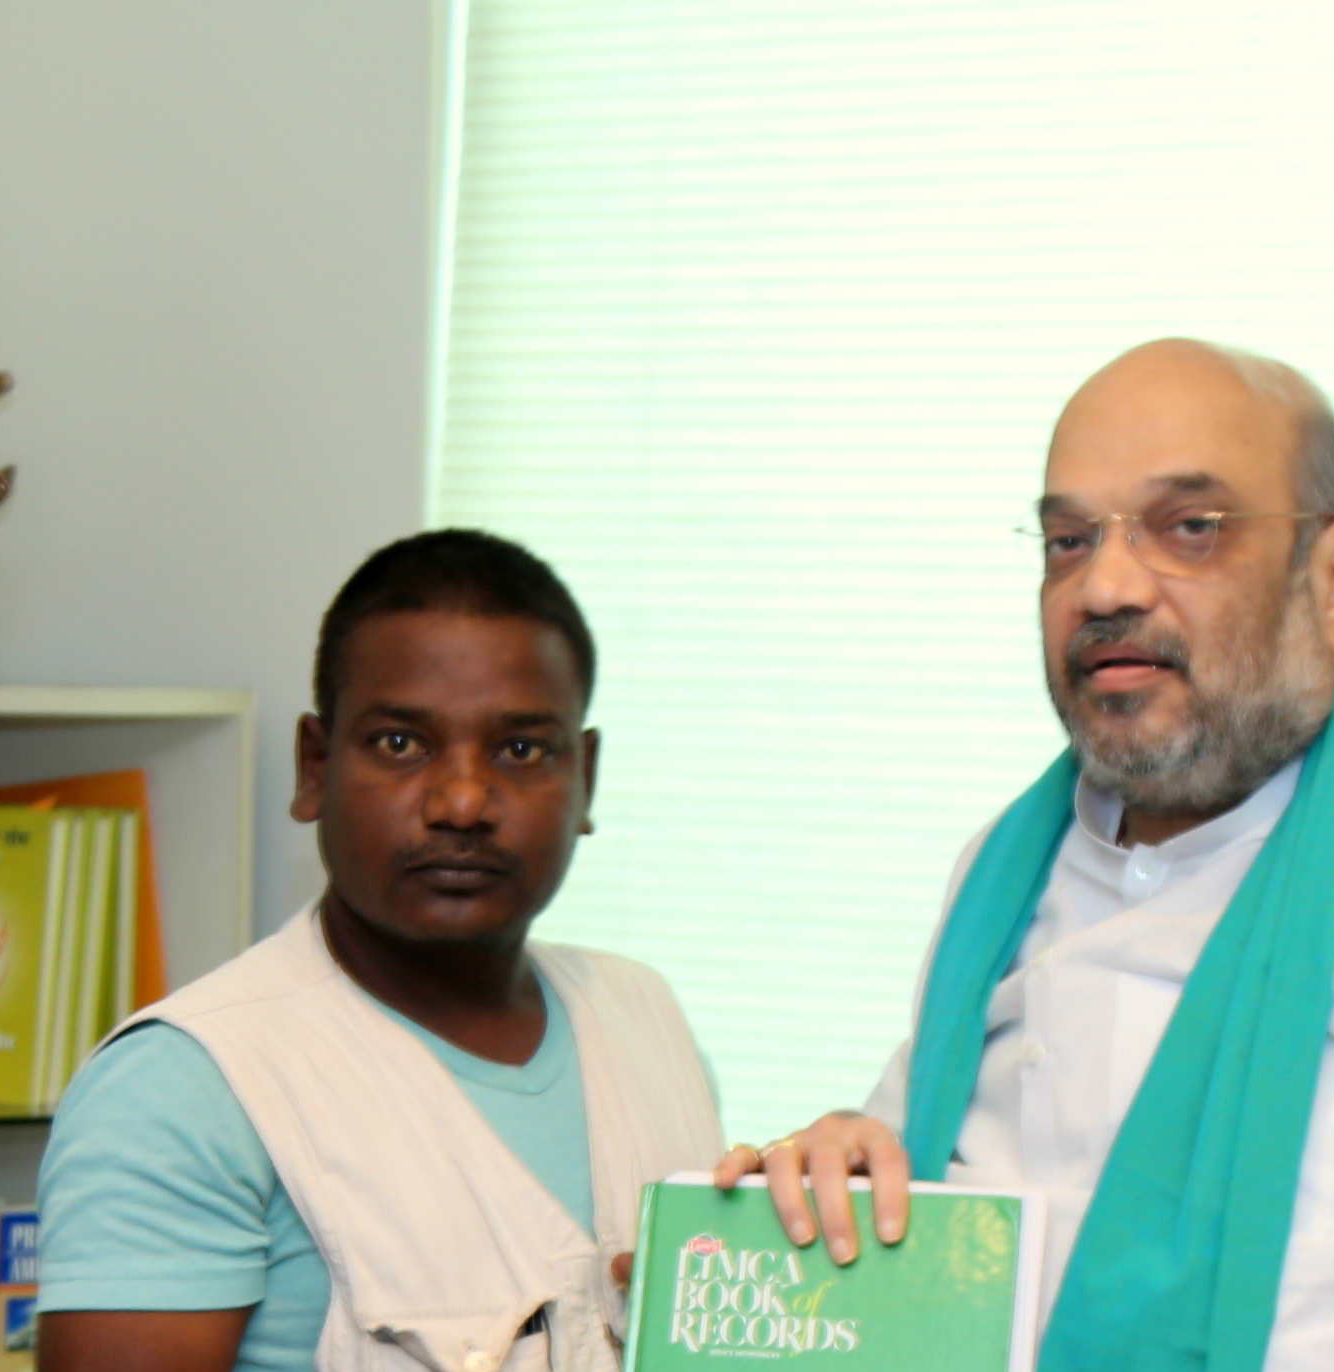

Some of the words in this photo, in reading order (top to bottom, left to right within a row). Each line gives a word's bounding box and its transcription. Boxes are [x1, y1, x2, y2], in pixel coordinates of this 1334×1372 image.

[676, 1248, 805, 1288] LIMCA
[673, 1280, 787, 1317] BOOK
[670, 1312, 861, 1353] RECORDS
